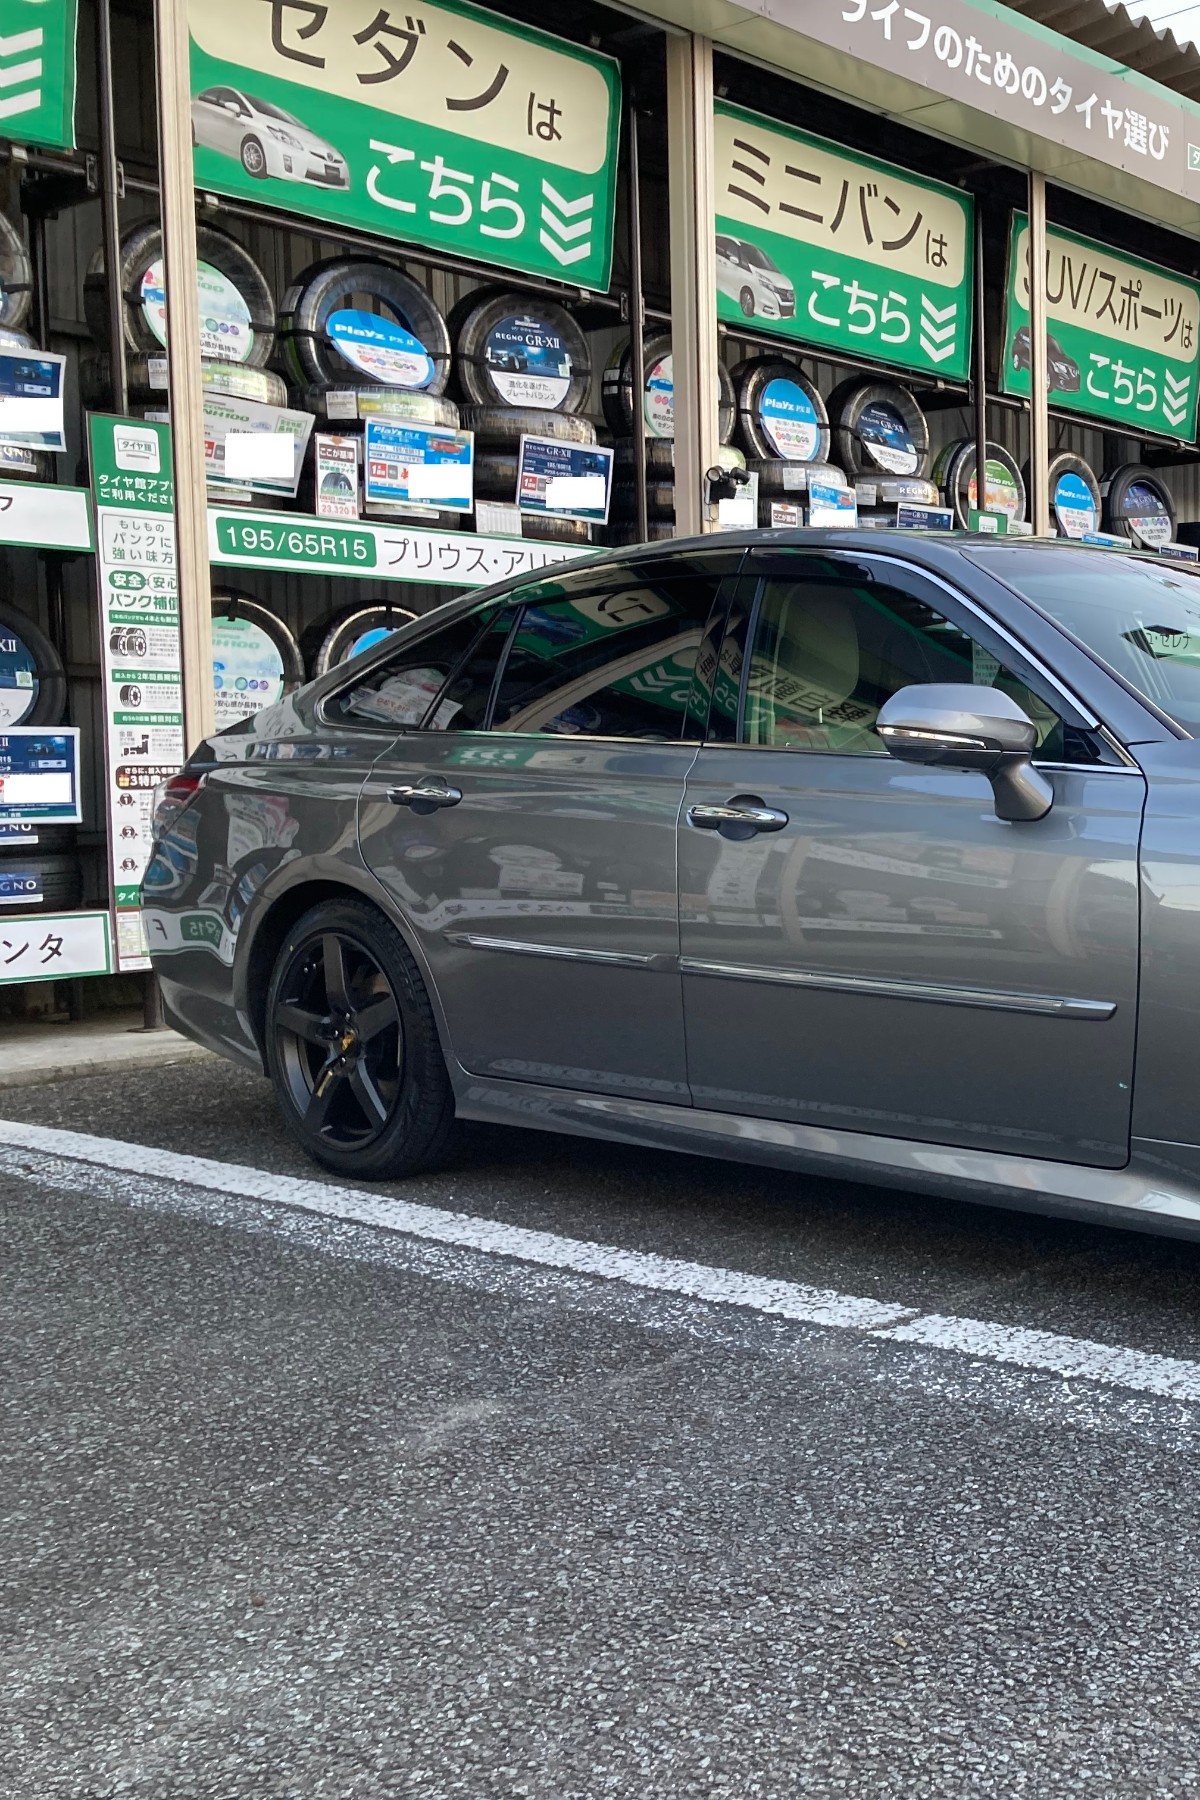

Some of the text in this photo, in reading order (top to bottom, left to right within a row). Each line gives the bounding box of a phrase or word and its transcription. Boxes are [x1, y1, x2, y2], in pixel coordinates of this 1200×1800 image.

[366, 139, 525, 239] こちら
[728, 138, 947, 267] ミニバンは
[808, 270, 911, 343] こちら
[496, 332, 523, 342] REGNO
[1086, 353, 1157, 411] こちら
[506, 390, 556, 401] グレートバランス
[120, 520, 164, 533] もしもの
[114, 533, 172, 548] パンクに
[226, 526, 368, 560] 195/65R15
[112, 548, 173, 564] 強い味方
[113, 573, 142, 588] 安全
[118, 892, 140, 901] タイ
